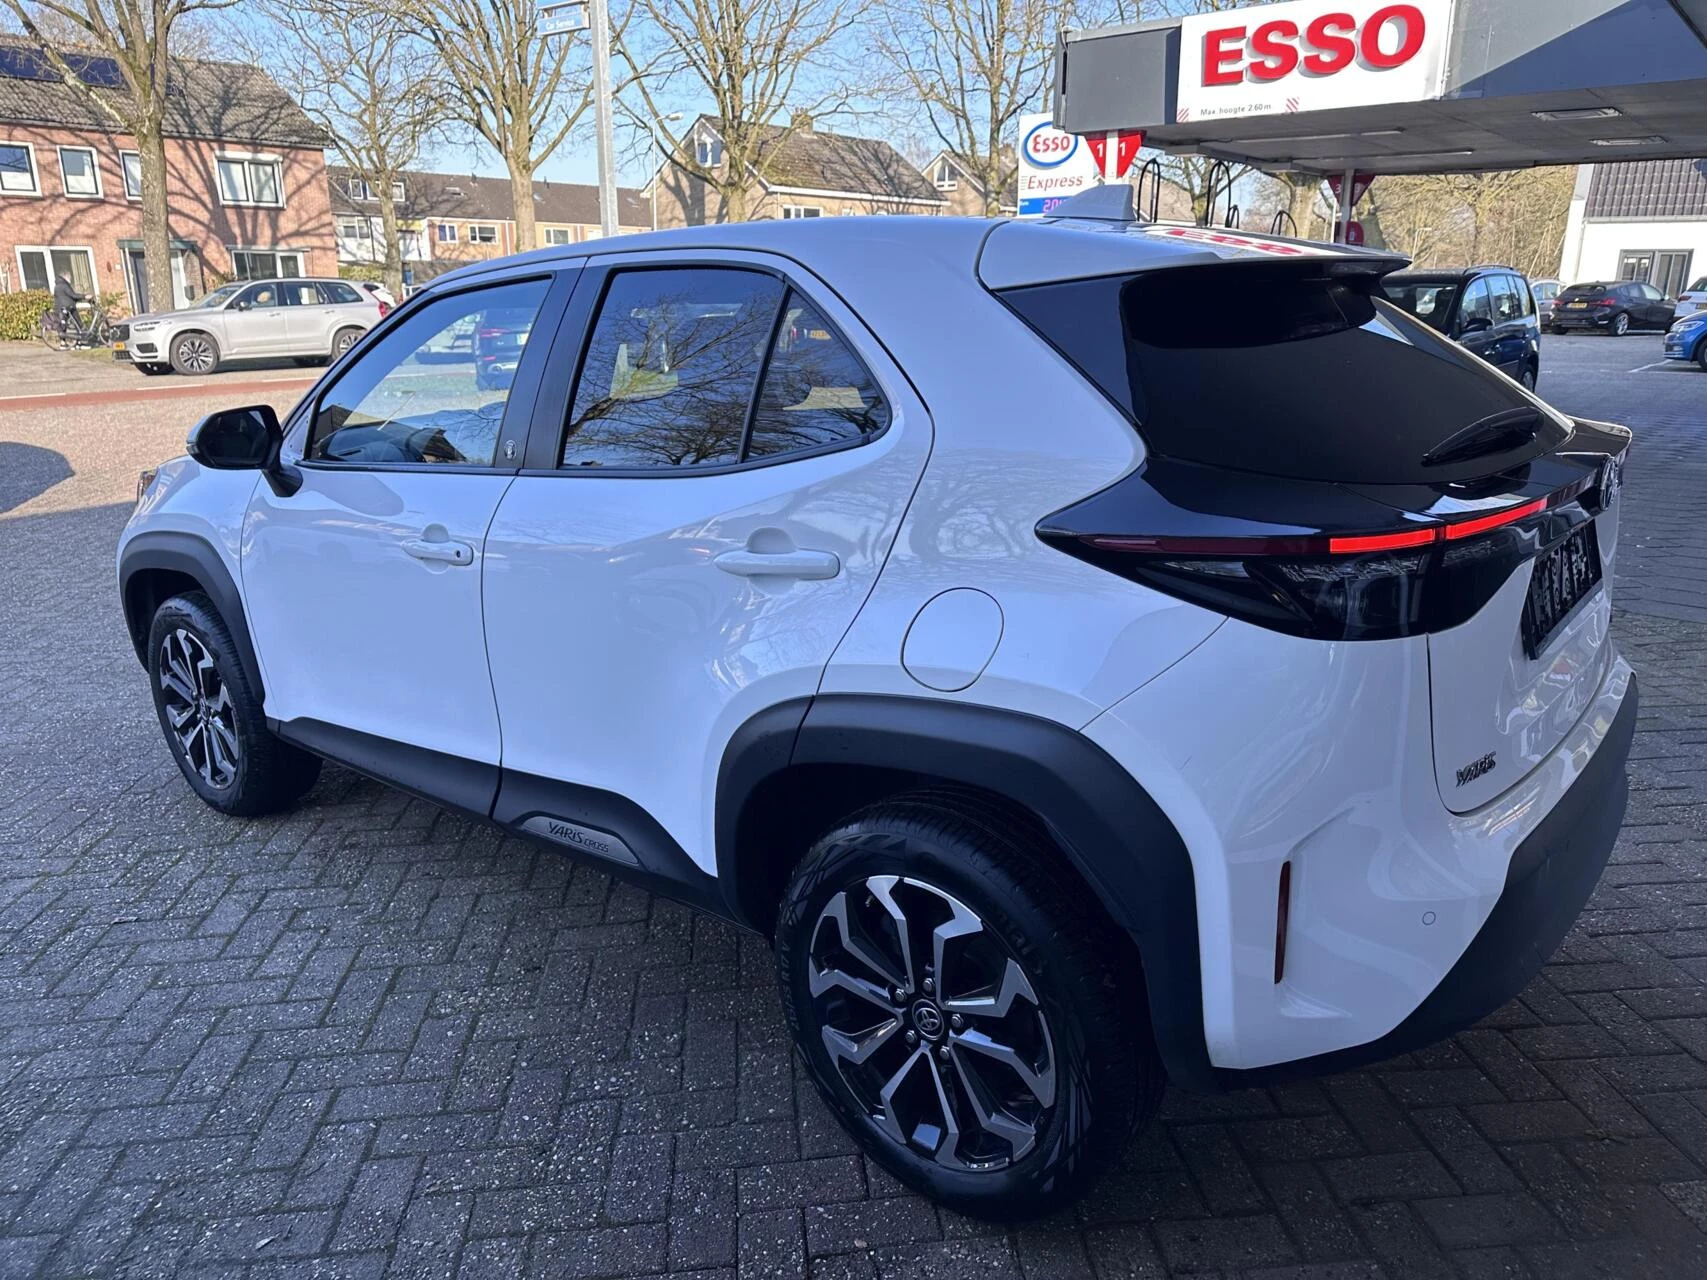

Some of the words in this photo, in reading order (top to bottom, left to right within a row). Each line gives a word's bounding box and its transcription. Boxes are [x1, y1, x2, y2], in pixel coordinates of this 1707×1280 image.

[1203, 4, 1426, 87] ESSO
[1219, 106, 1245, 114] hoogte
[1248, 103, 1263, 112] 2.60
[1032, 134, 1071, 153] Esso
[1097, 142, 1104, 158] 1
[1119, 141, 1126, 157] 1
[1027, 175, 1084, 191] Express
[583, 838, 609, 853] CROSS
